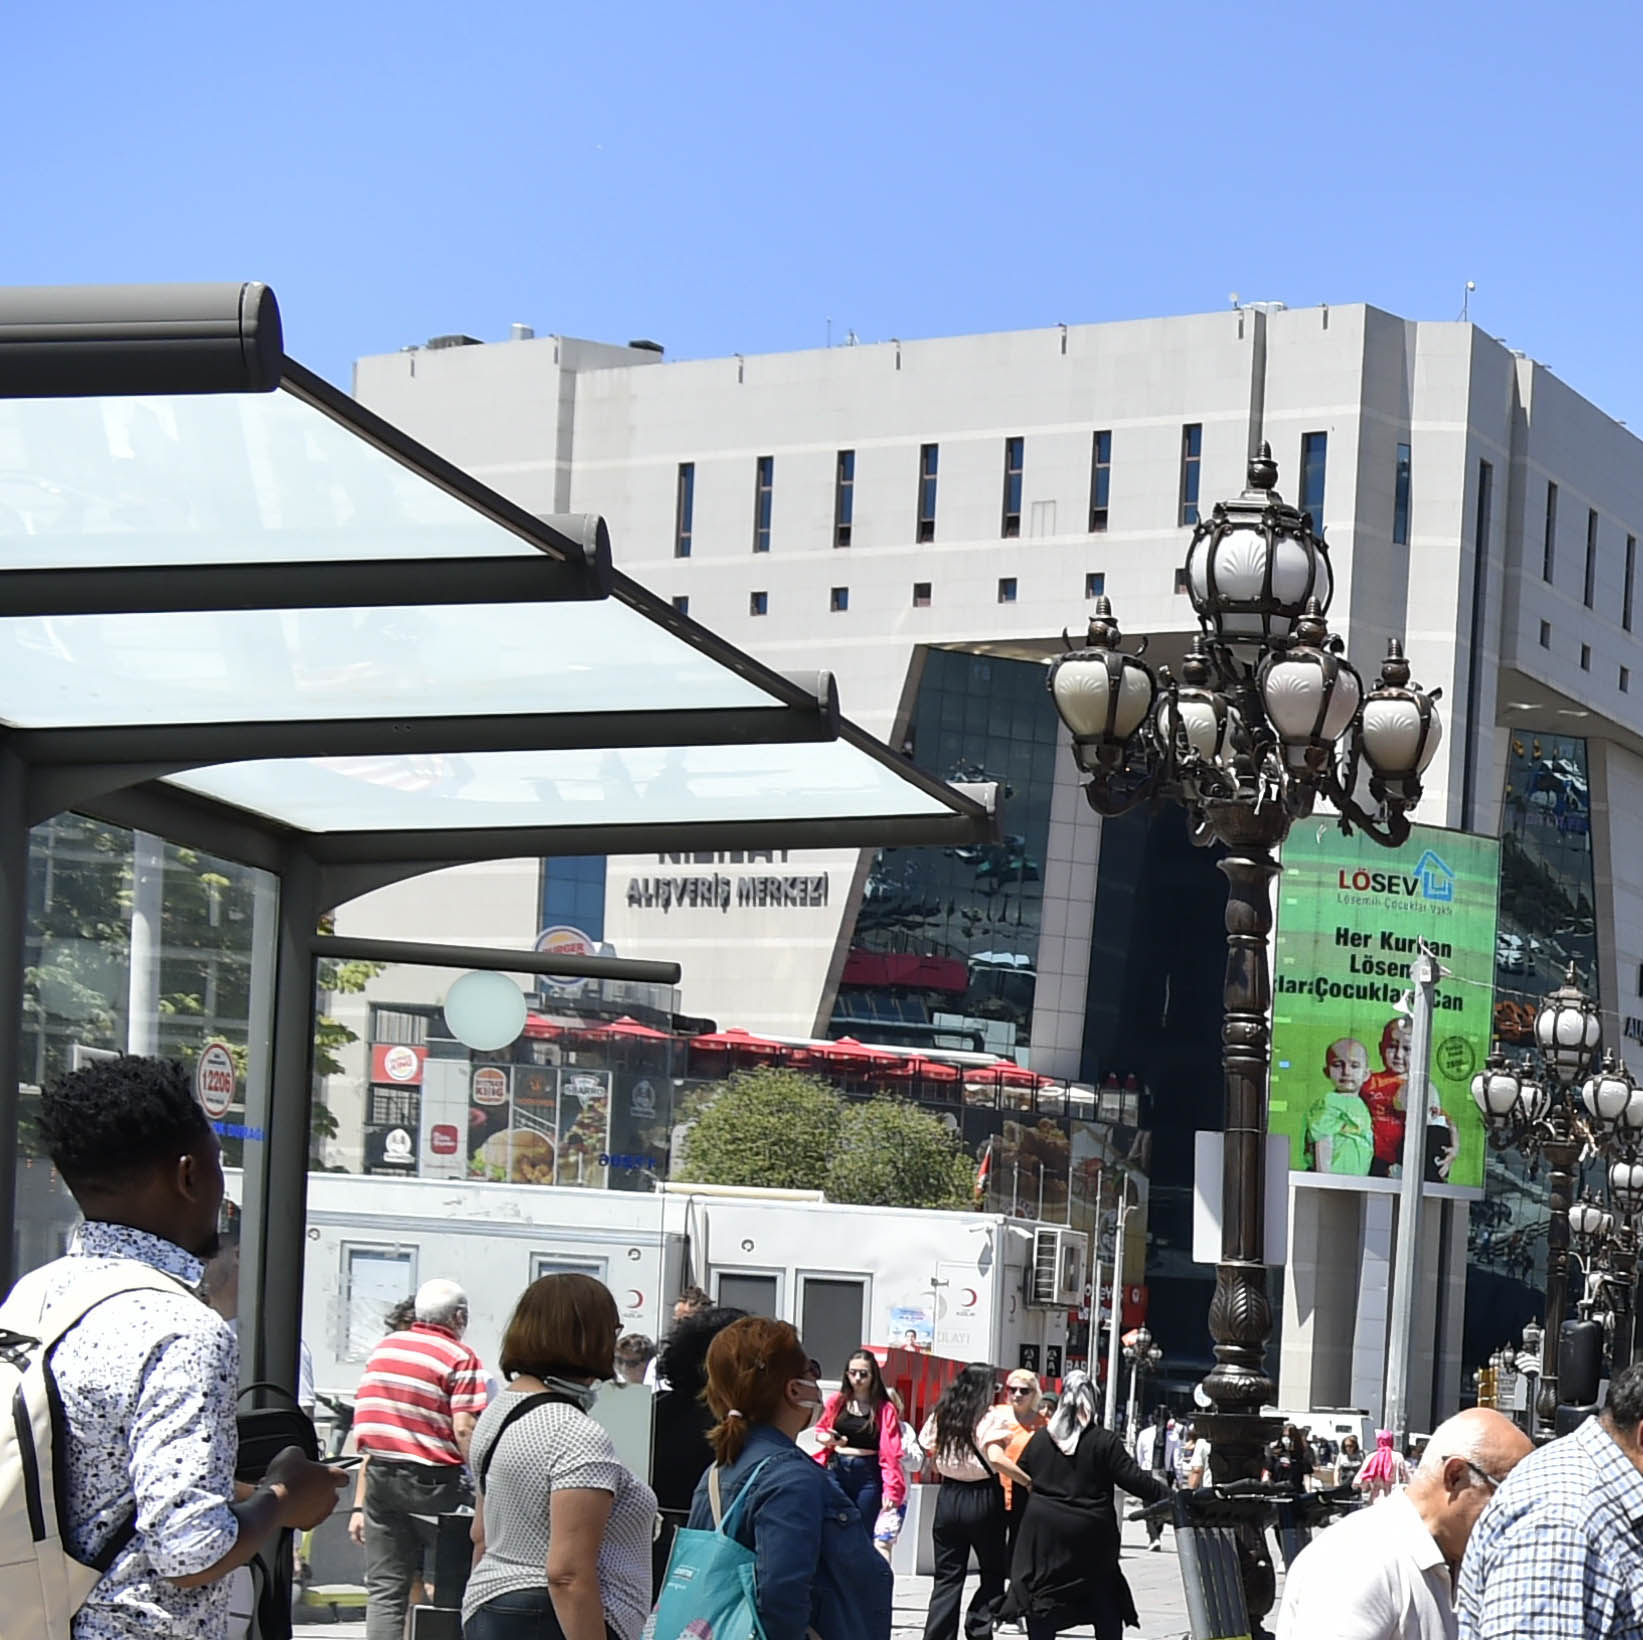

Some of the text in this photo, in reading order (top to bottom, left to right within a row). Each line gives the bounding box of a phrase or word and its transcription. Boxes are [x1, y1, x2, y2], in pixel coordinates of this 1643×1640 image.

[627, 871, 829, 914] ALIŞVERİŞ MERKEZİ
[1339, 868, 1419, 897] LÖSEV
[1335, 926, 1372, 948] Her
